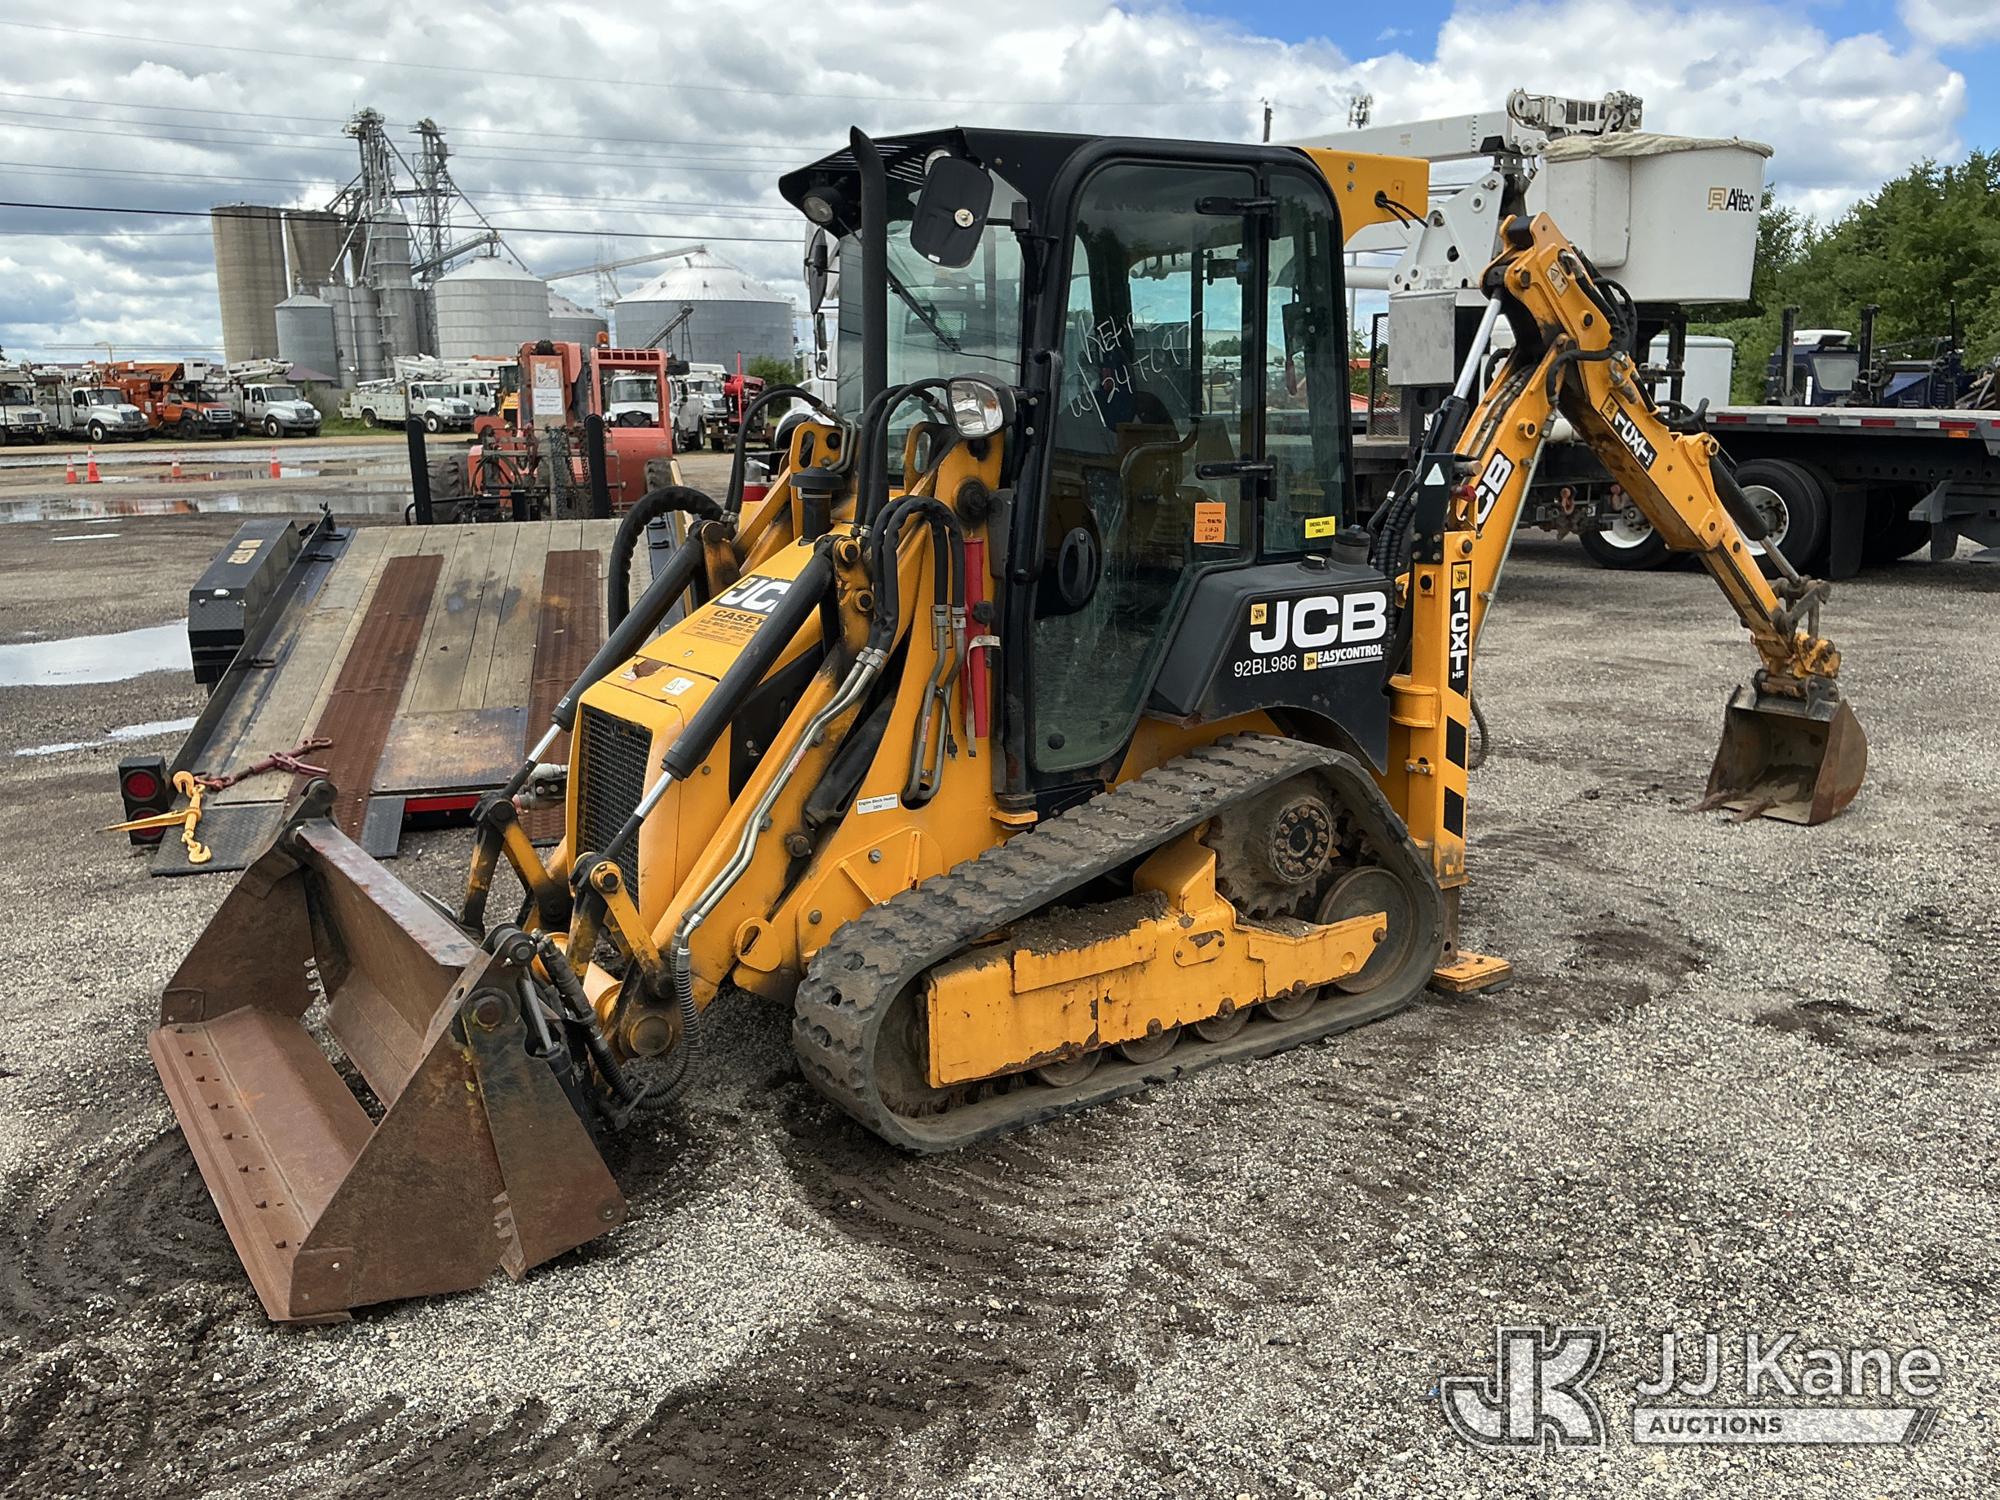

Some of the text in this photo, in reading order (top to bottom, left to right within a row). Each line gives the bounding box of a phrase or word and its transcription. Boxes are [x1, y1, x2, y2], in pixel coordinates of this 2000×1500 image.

[1725, 188, 1754, 212] Altec
[718, 578, 792, 613] JC
[1250, 591, 1387, 654] JCB
[1450, 591, 1469, 671] 1CXT
[1234, 654, 1297, 678] 92BL986
[1317, 644, 1383, 664] EASYCONTROL
